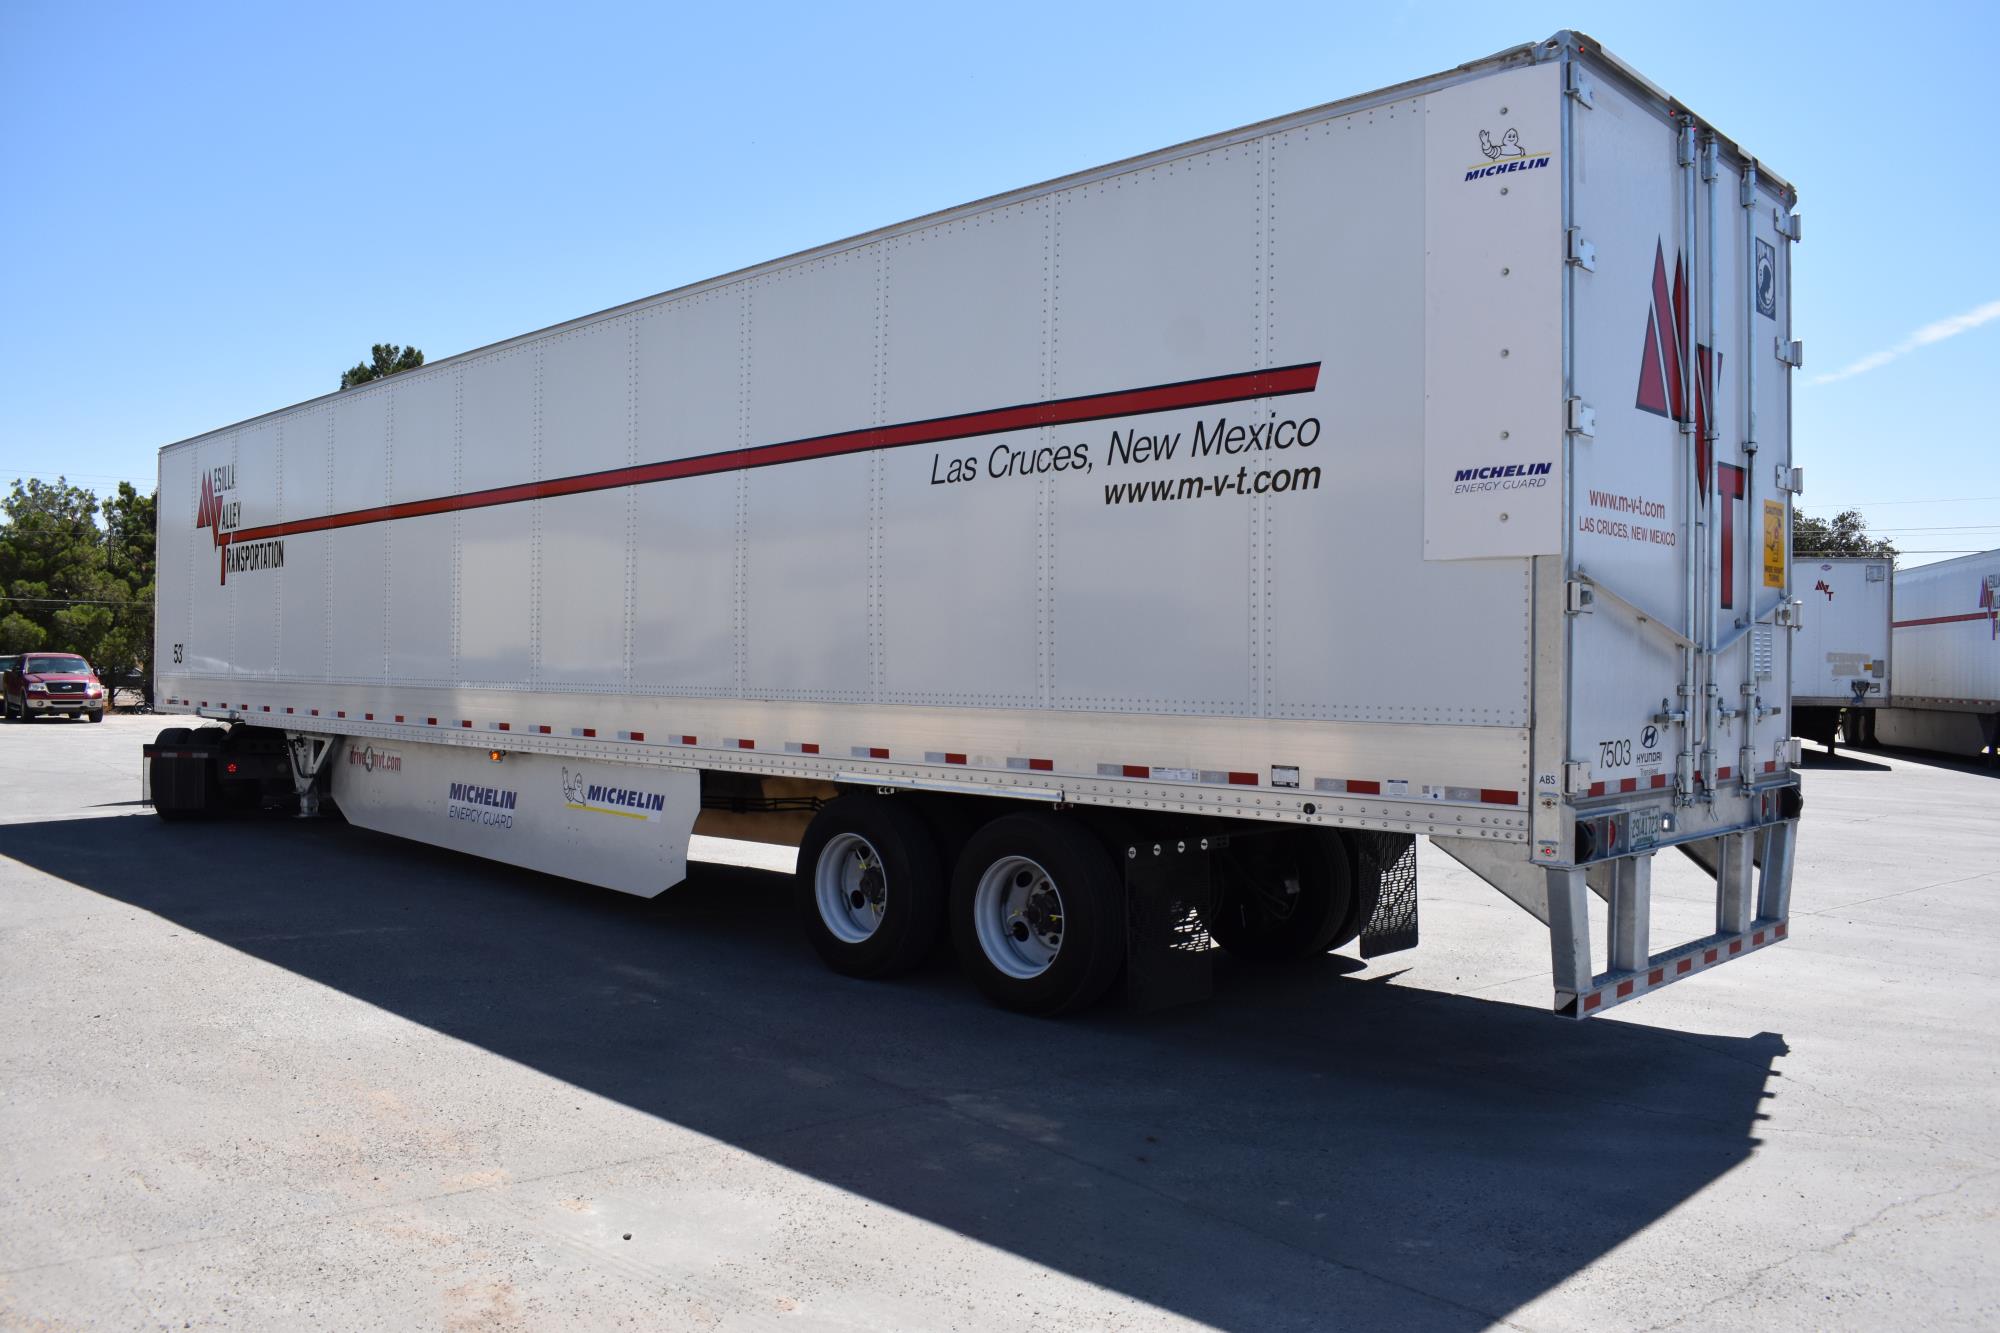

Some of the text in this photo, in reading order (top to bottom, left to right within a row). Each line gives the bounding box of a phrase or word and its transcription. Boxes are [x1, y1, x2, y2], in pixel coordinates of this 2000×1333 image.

[1465, 157, 1550, 182] MICHELIN
[930, 412, 1321, 485] Las Cruces, New Mexico
[1104, 465, 1322, 505] www.m-v-t.com
[1454, 462, 1552, 481] MICHELIN
[1454, 477, 1546, 494] ENERGY GUARD
[1589, 489, 1665, 519] www.m-v-t.com
[1579, 516, 1676, 546] LAS CRUCES, NEW MEXICO
[1599, 739, 1631, 769] 7503
[1636, 751, 1663, 764] HYUNDAI
[1539, 775, 1556, 785] ABS
[449, 783, 517, 810] MICHELIN
[587, 784, 665, 811] MICHELIN
[449, 805, 513, 830] ENERGY GUARD
